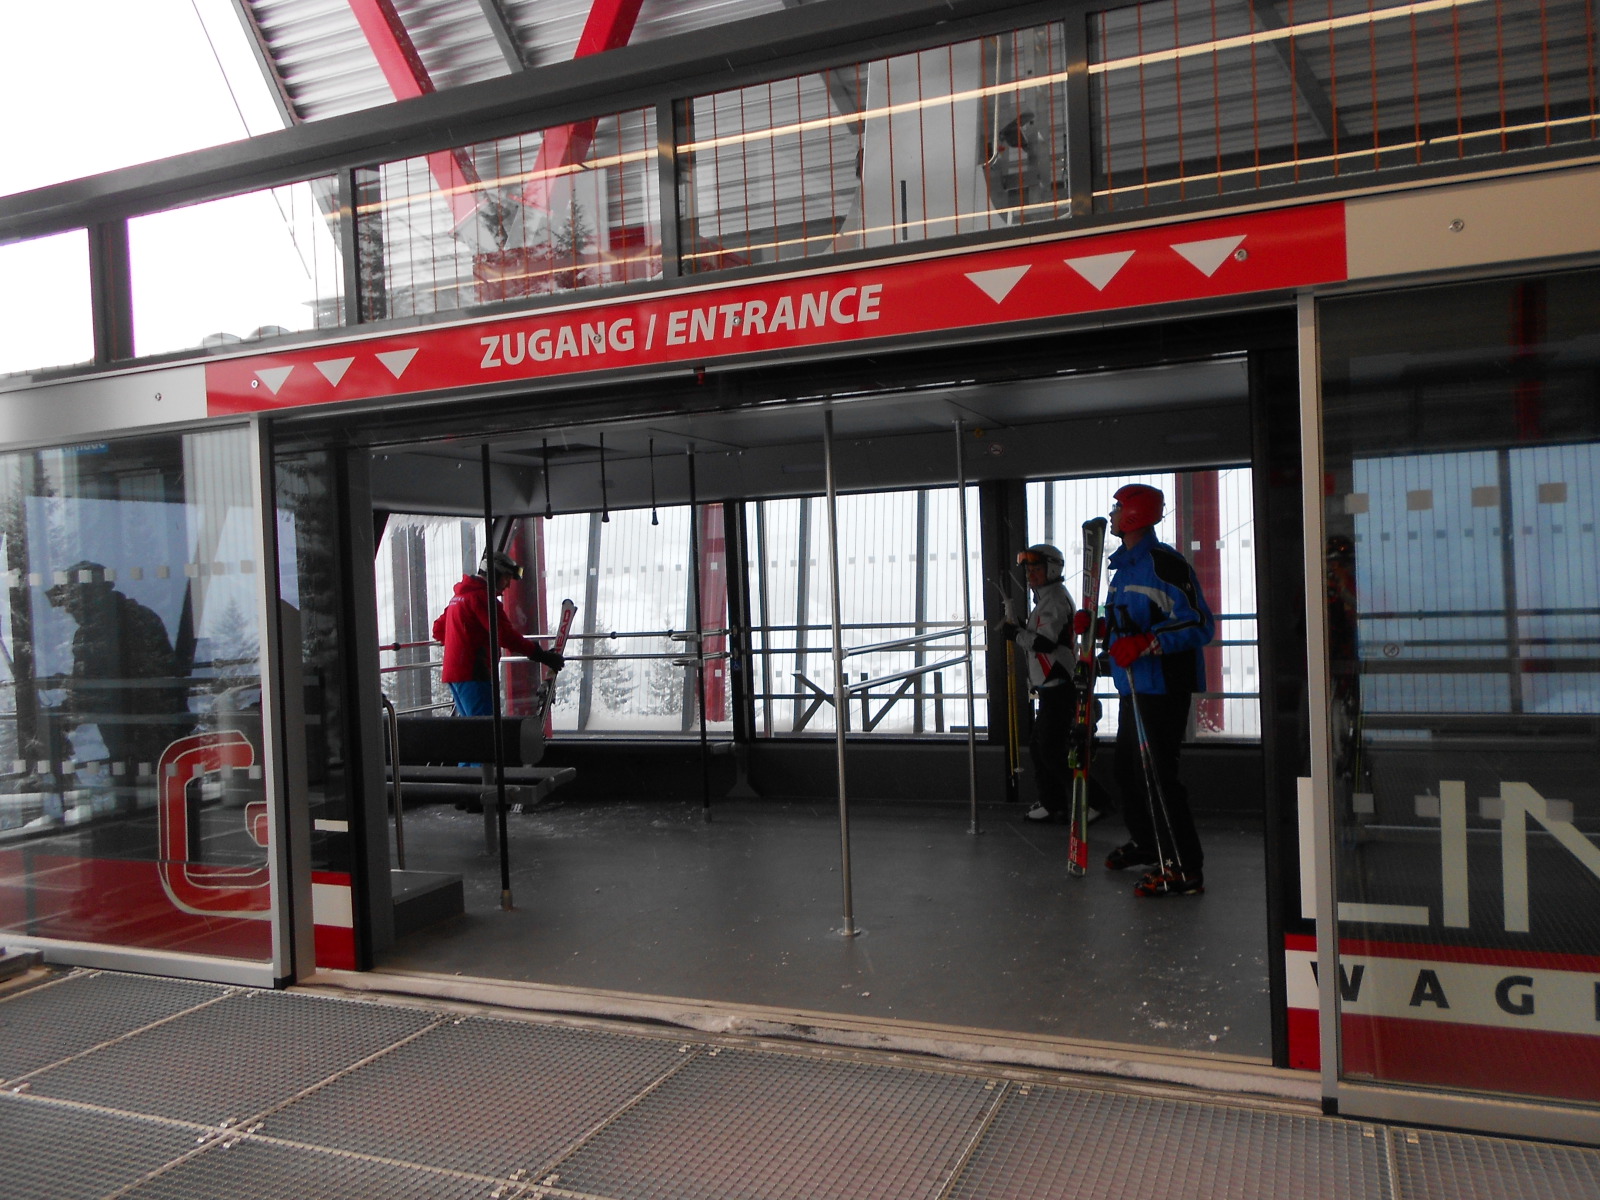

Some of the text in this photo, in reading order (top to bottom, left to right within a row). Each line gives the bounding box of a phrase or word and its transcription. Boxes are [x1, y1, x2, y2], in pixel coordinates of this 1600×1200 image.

[480, 283, 883, 369] ZUGANG / ENTRANCE
